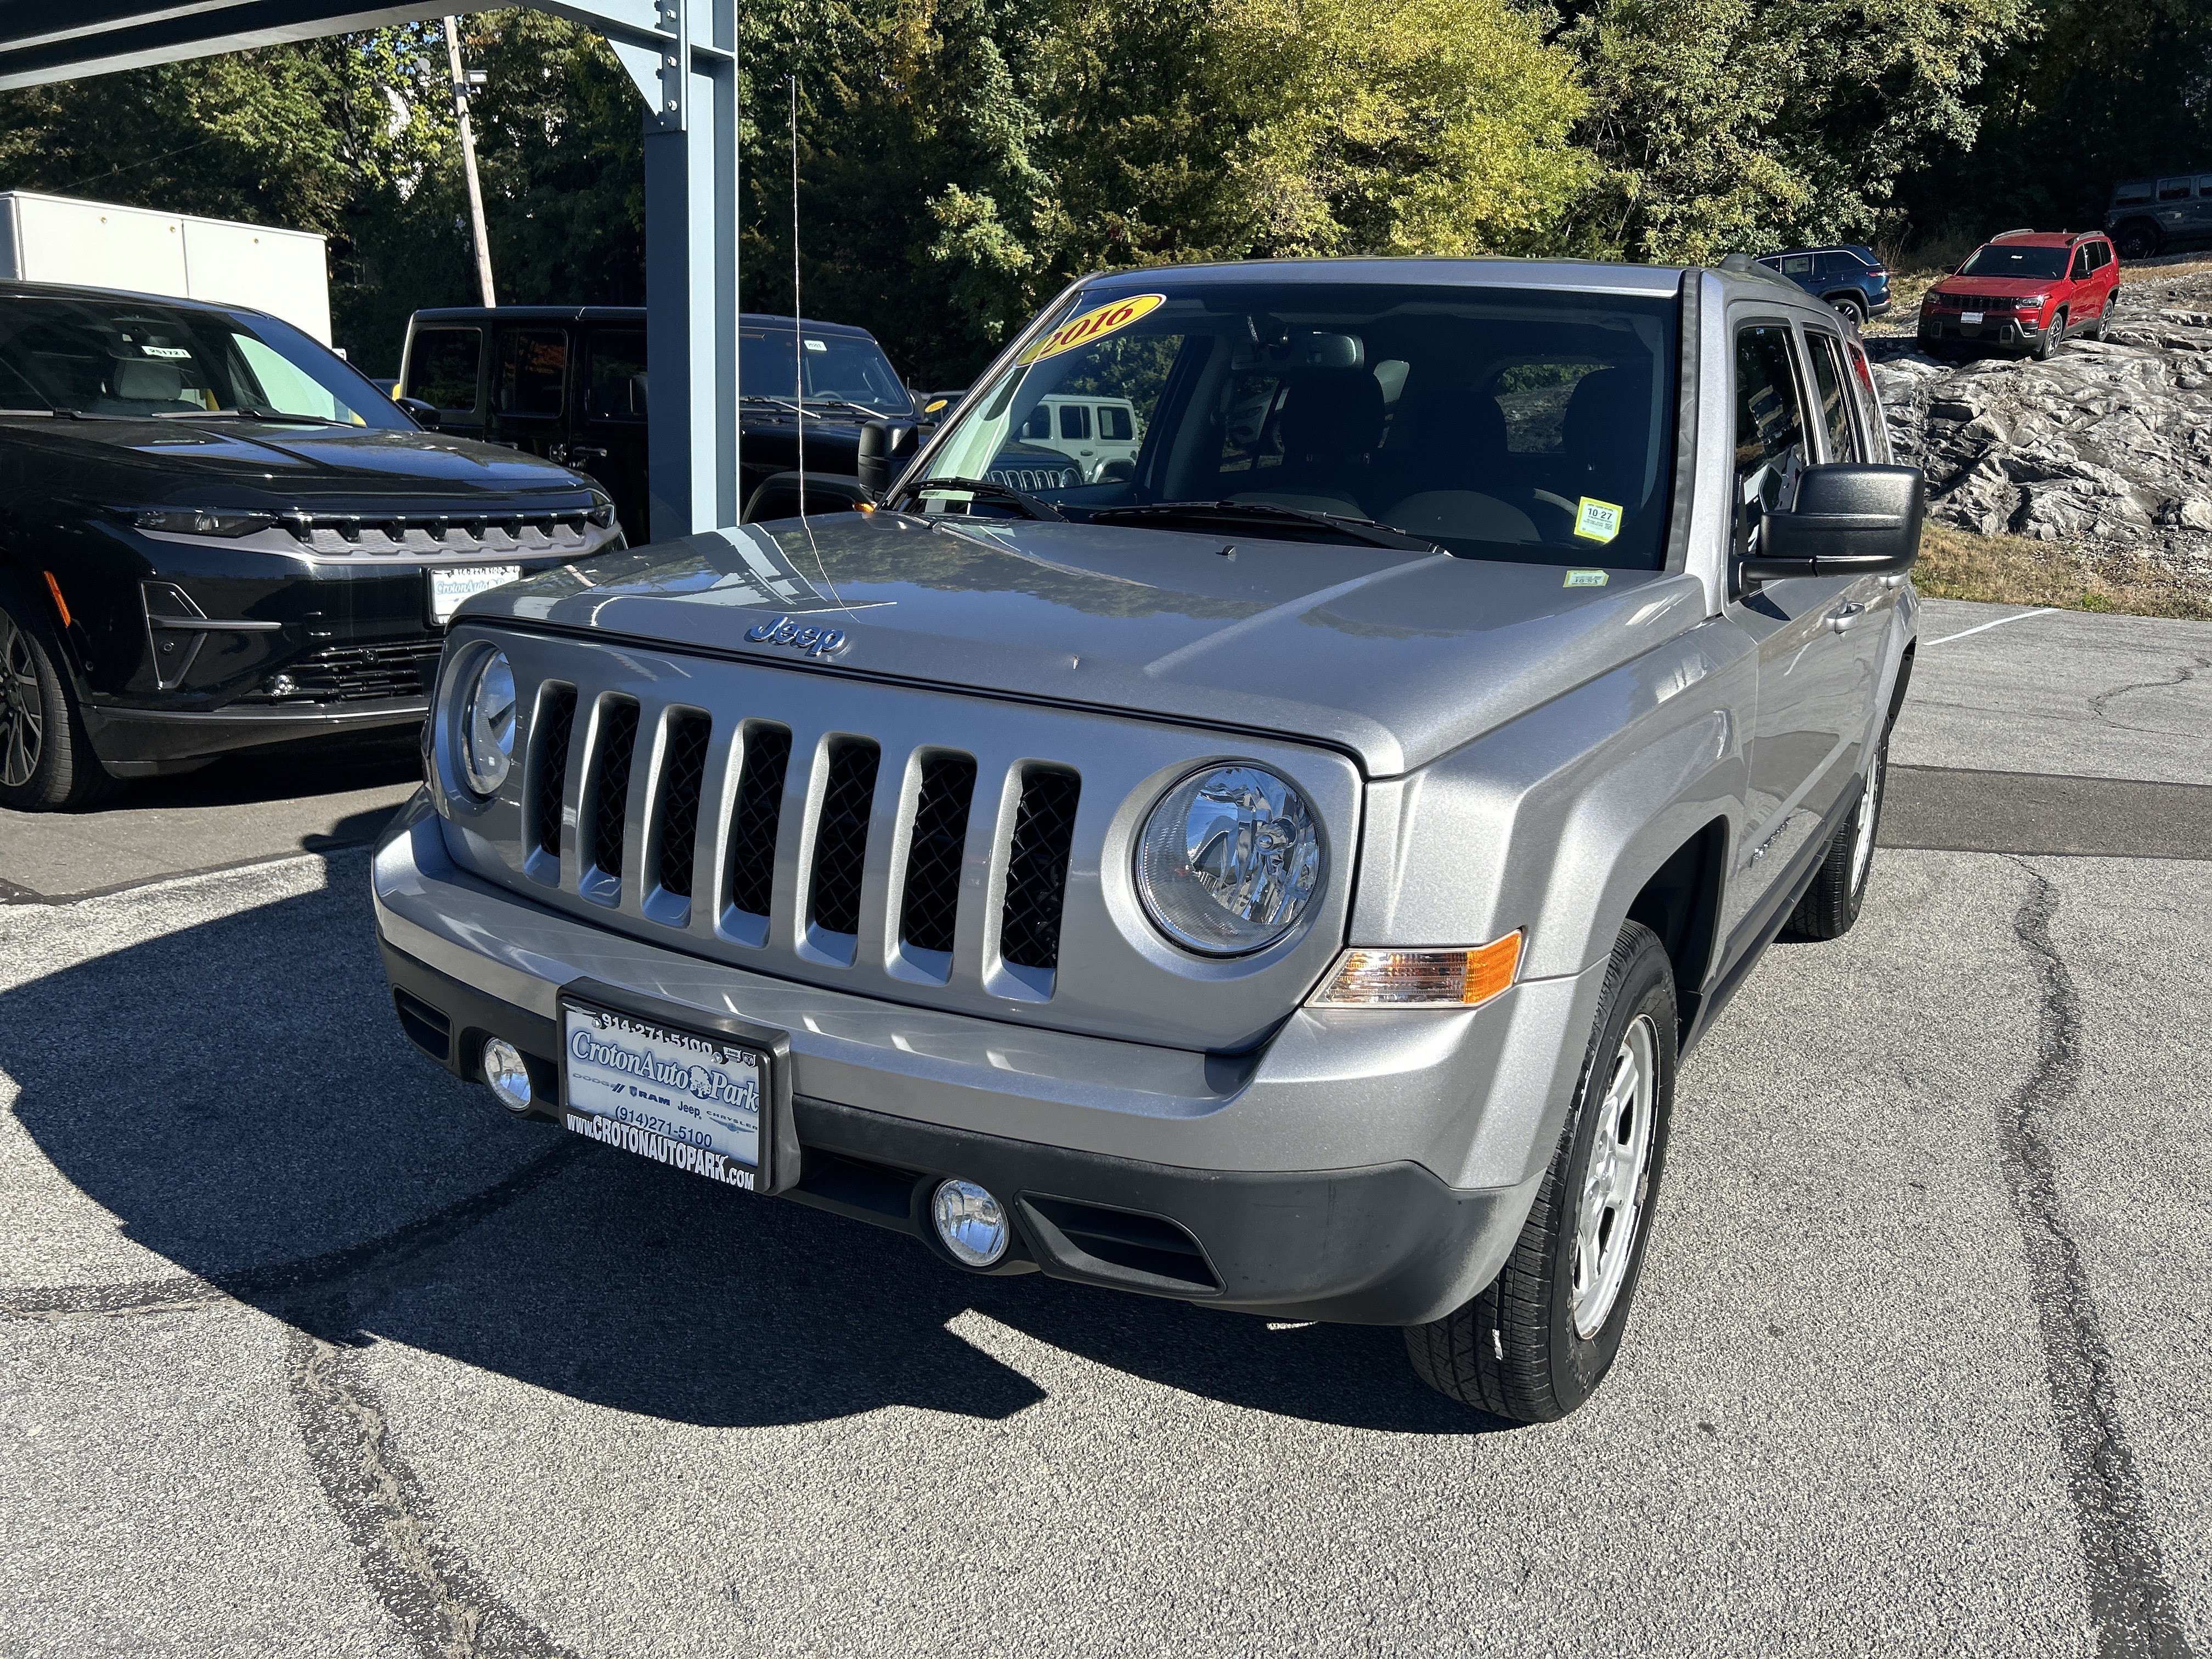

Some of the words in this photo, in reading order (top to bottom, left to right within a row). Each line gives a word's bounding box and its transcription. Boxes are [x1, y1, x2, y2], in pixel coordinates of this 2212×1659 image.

[1040, 298, 1142, 356] 2016
[1588, 508, 1598, 517] 10
[1600, 511, 1612, 520] 27
[750, 615, 846, 657] Jeep
[639, 1091, 670, 1106] RAM
[709, 1070, 759, 1113] Park
[678, 1101, 700, 1118] Jeep
[707, 1110, 758, 1130] CHRYSLER
[616, 1105, 712, 1147] (914)271-5100
